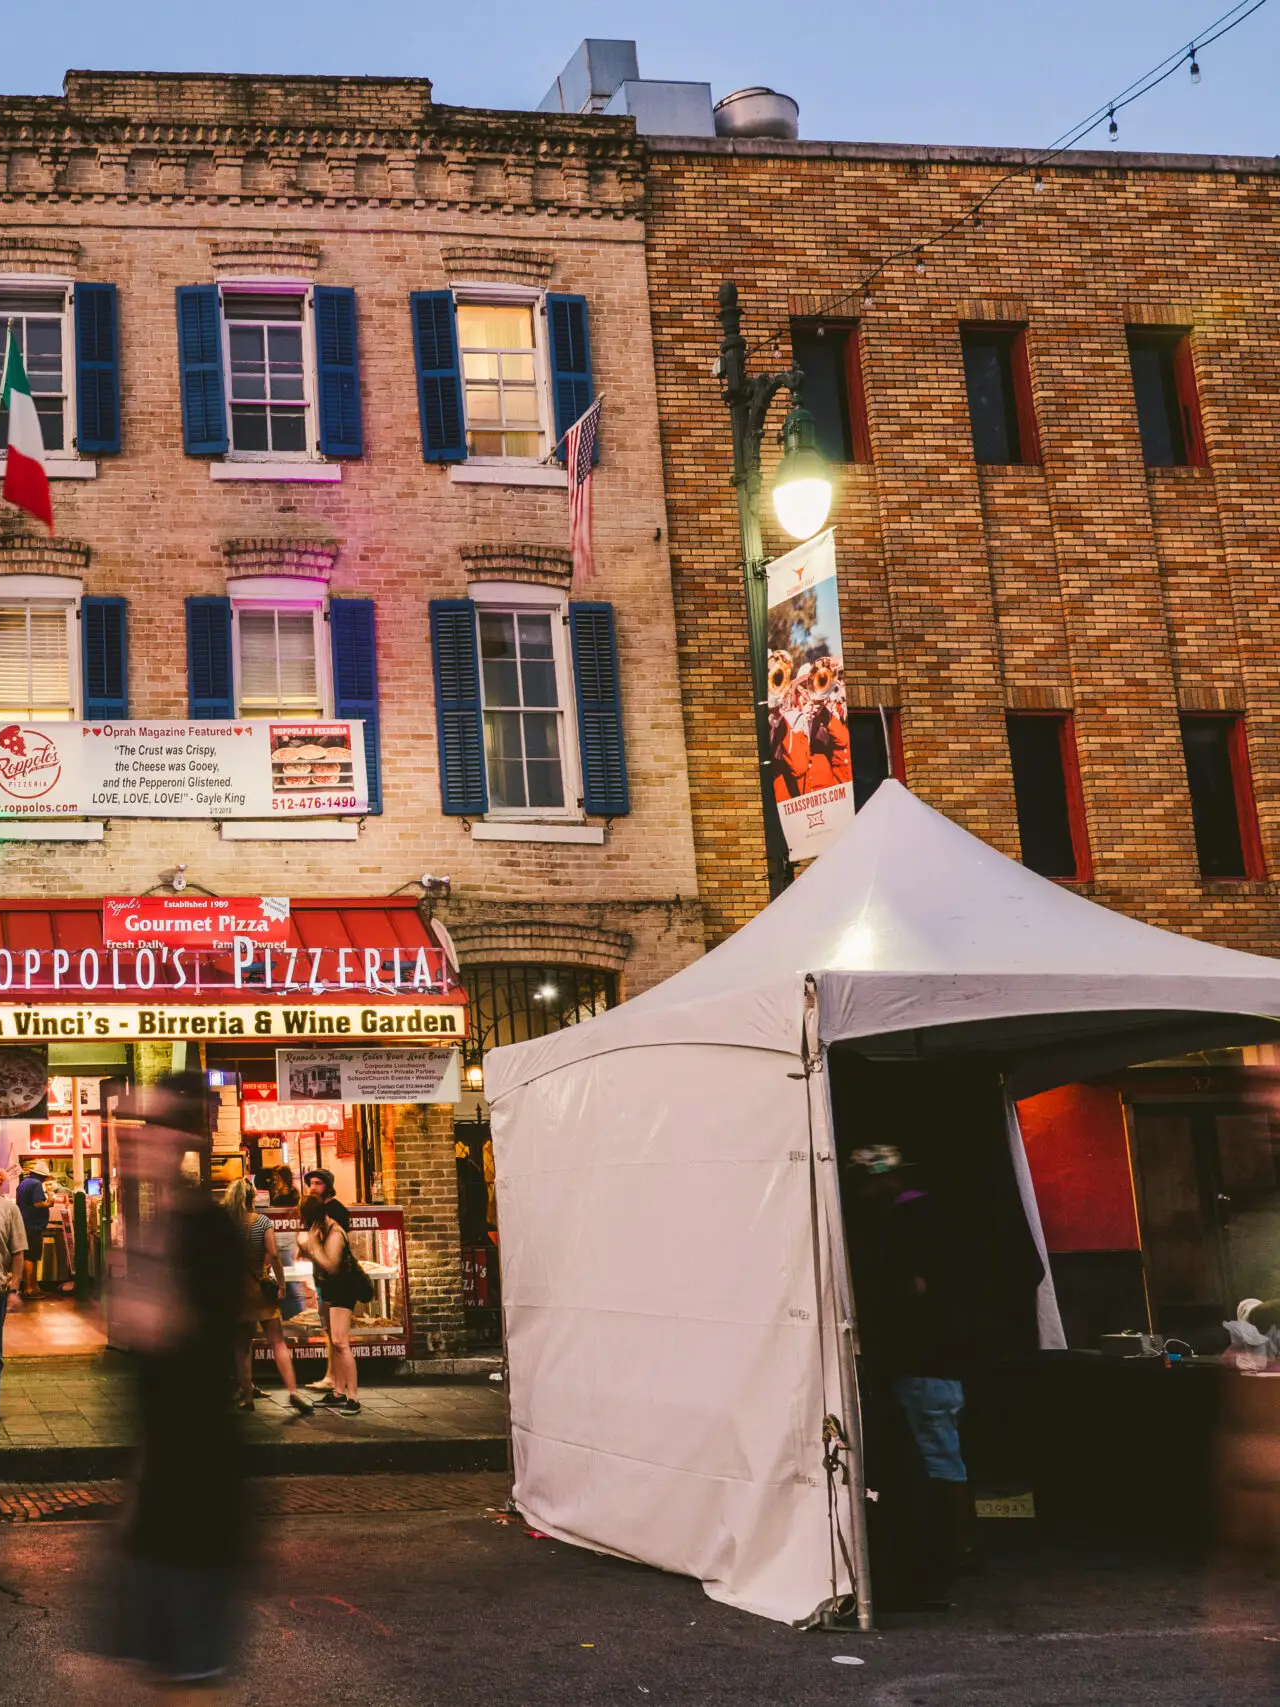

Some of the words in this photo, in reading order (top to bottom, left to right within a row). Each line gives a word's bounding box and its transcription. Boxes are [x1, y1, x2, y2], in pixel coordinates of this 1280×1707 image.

[103, 725, 136, 739] Oprah
[139, 727, 185, 739] Magazine
[189, 726, 232, 737] Featured
[138, 745, 163, 756] Crust
[166, 746, 183, 755] was
[185, 744, 217, 758] Crispy,
[115, 761, 130, 772] the
[132, 761, 166, 772] Cheese
[169, 763, 186, 772] was
[8, 780, 48, 788] PIZZERIA
[102, 777, 120, 788] and
[122, 777, 137, 788] the
[139, 776, 186, 790] Pepperoni
[188, 776, 233, 788] Glistened.
[92, 793, 121, 806] LOVE,
[123, 793, 152, 806] LOVE,
[196, 793, 222, 806] Gayle
[224, 793, 246, 806] King
[272, 796, 357, 810] 512-476-1490
[783, 786, 846, 816] TEXASSPORTS.COM
[164, 900, 208, 909] Established
[210, 900, 229, 909] 1989
[125, 914, 212, 932] Gourmet
[218, 915, 269, 932] Pizza
[106, 939, 135, 949] Fresh
[13, 1010, 110, 1036] Vinci's
[138, 1010, 244, 1036] Birreria
[254, 1011, 272, 1035] &
[282, 1011, 351, 1034] Wine
[361, 1009, 457, 1033] Garden
[372, 1346, 382, 1356] 25
[383, 1344, 406, 1356] YEARS
